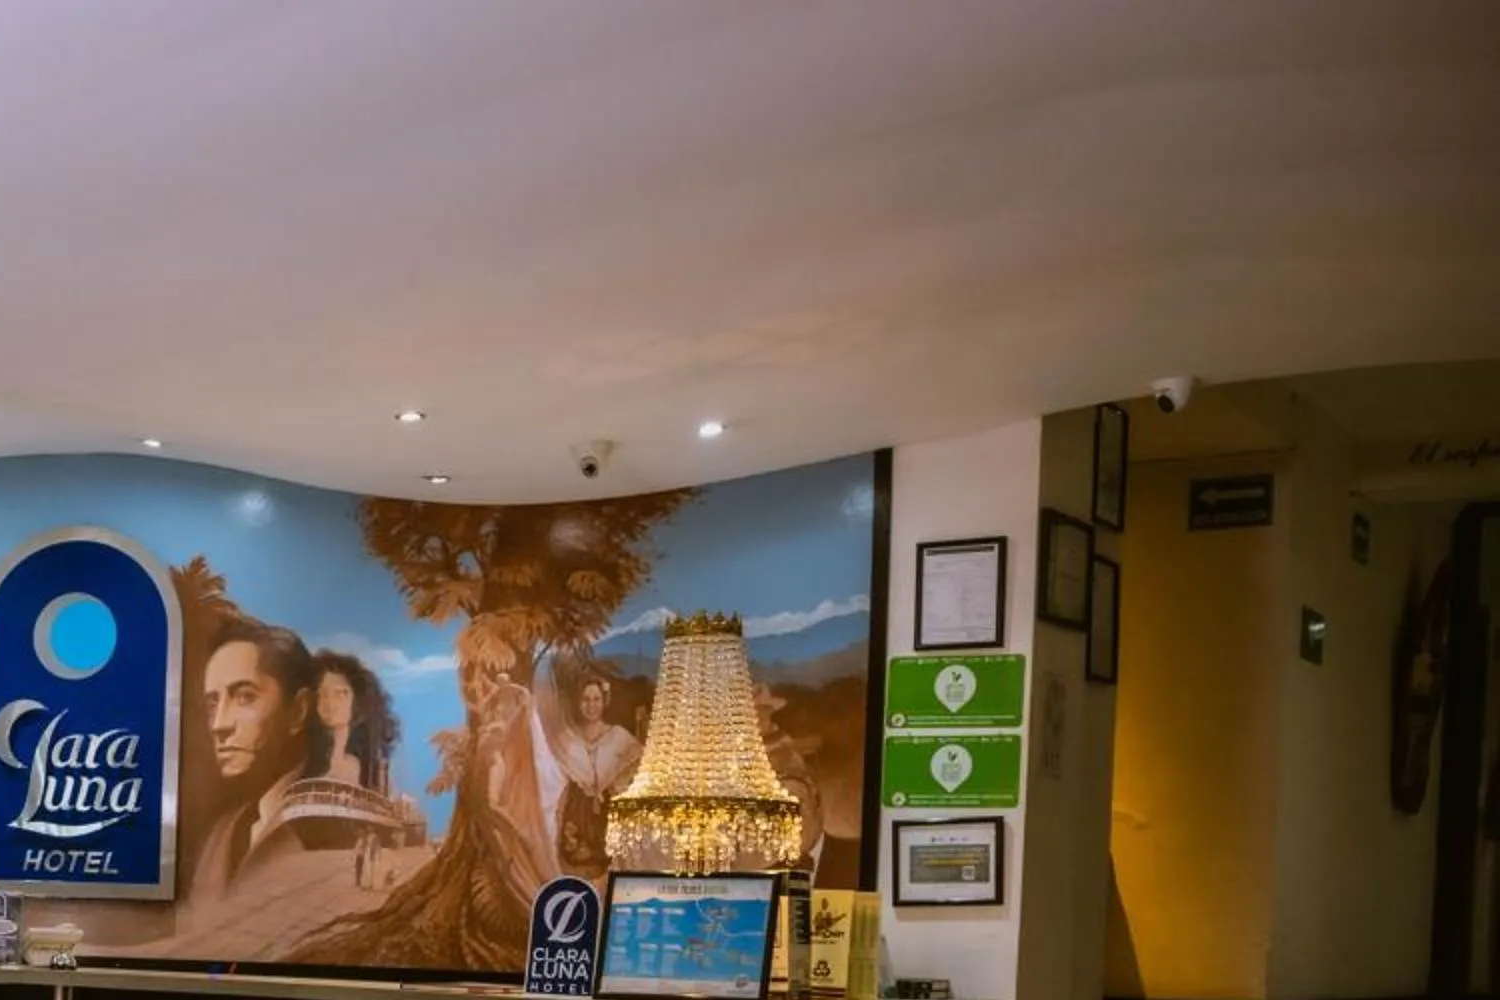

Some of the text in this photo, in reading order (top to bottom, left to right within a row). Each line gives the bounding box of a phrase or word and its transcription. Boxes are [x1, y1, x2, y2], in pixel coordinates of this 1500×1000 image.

[7, 742, 144, 837] Luna
[22, 848, 119, 874] HOTEL
[533, 947, 591, 963] CLARA
[531, 961, 589, 980] LUNA
[529, 982, 588, 995] HOTEL
